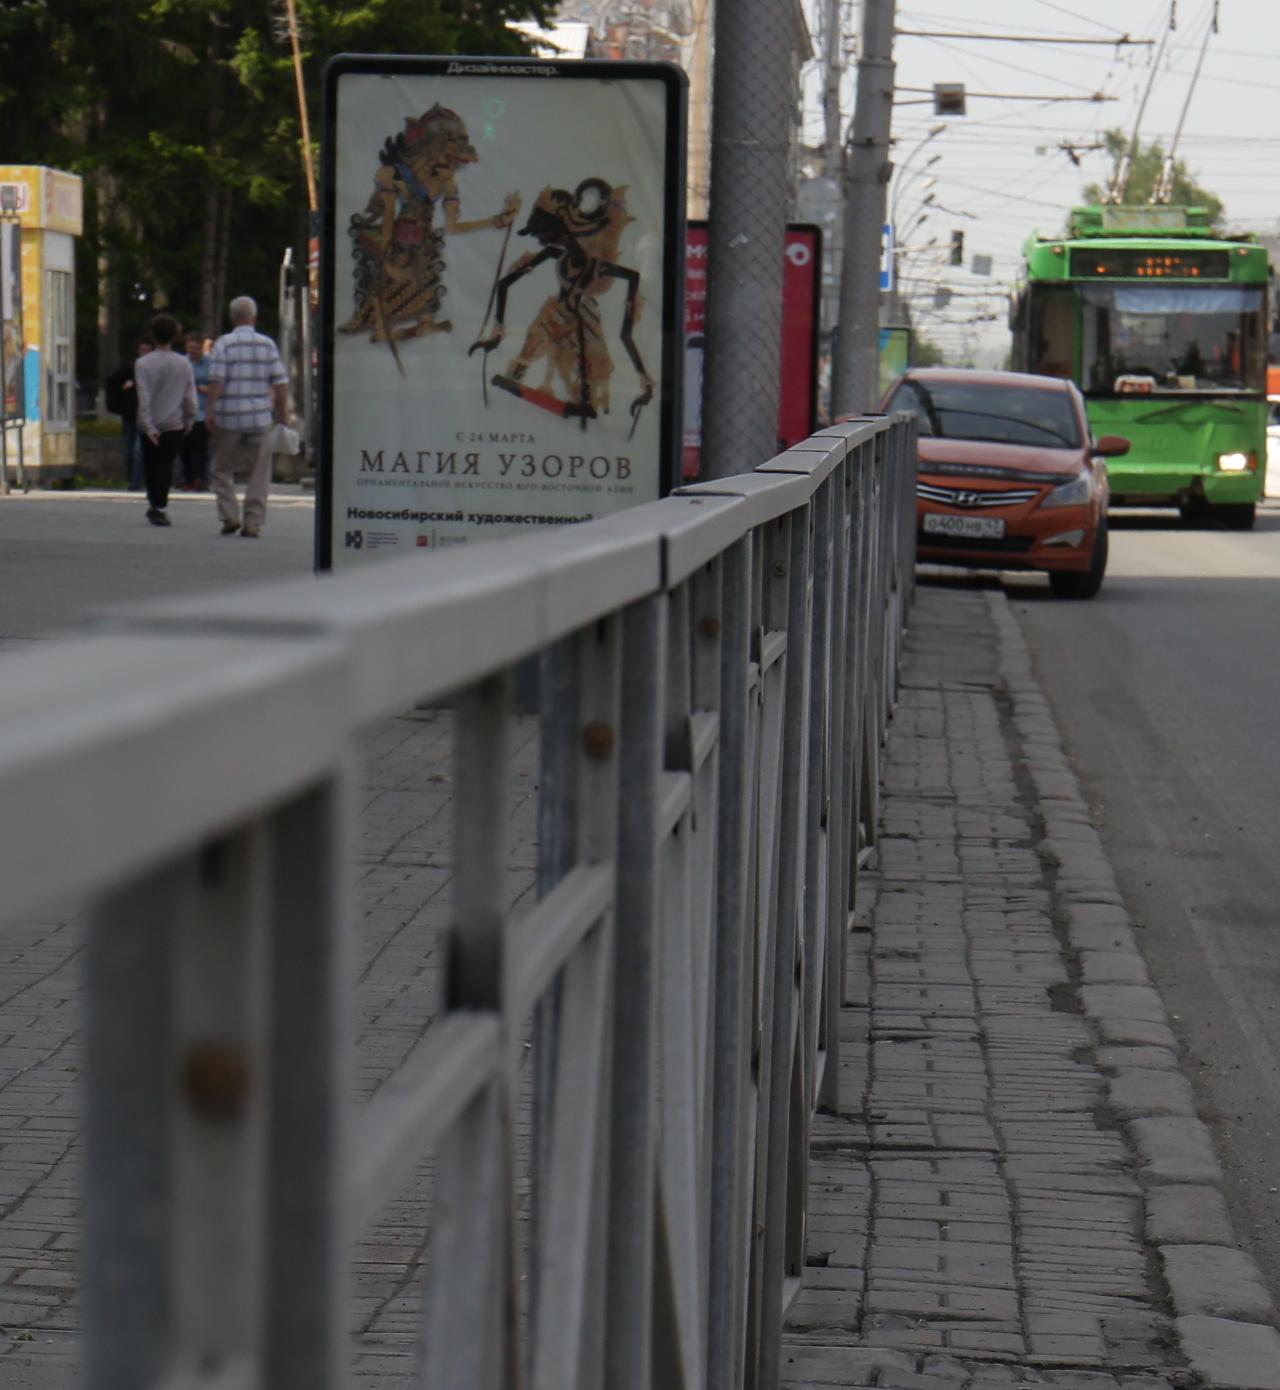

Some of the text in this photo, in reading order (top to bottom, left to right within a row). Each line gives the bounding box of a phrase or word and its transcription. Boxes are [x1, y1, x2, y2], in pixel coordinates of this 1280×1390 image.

[470, 432, 483, 442] 24
[489, 433, 535, 444] МАРТА
[360, 449, 632, 479] МАГИЯ УЗОРОВ
[356, 478, 450, 489] ОРНАМЕНТАЛЬНОЕ
[454, 480, 513, 490] ИСКУССТВО
[347, 506, 593, 525] Новосибирский художественный
